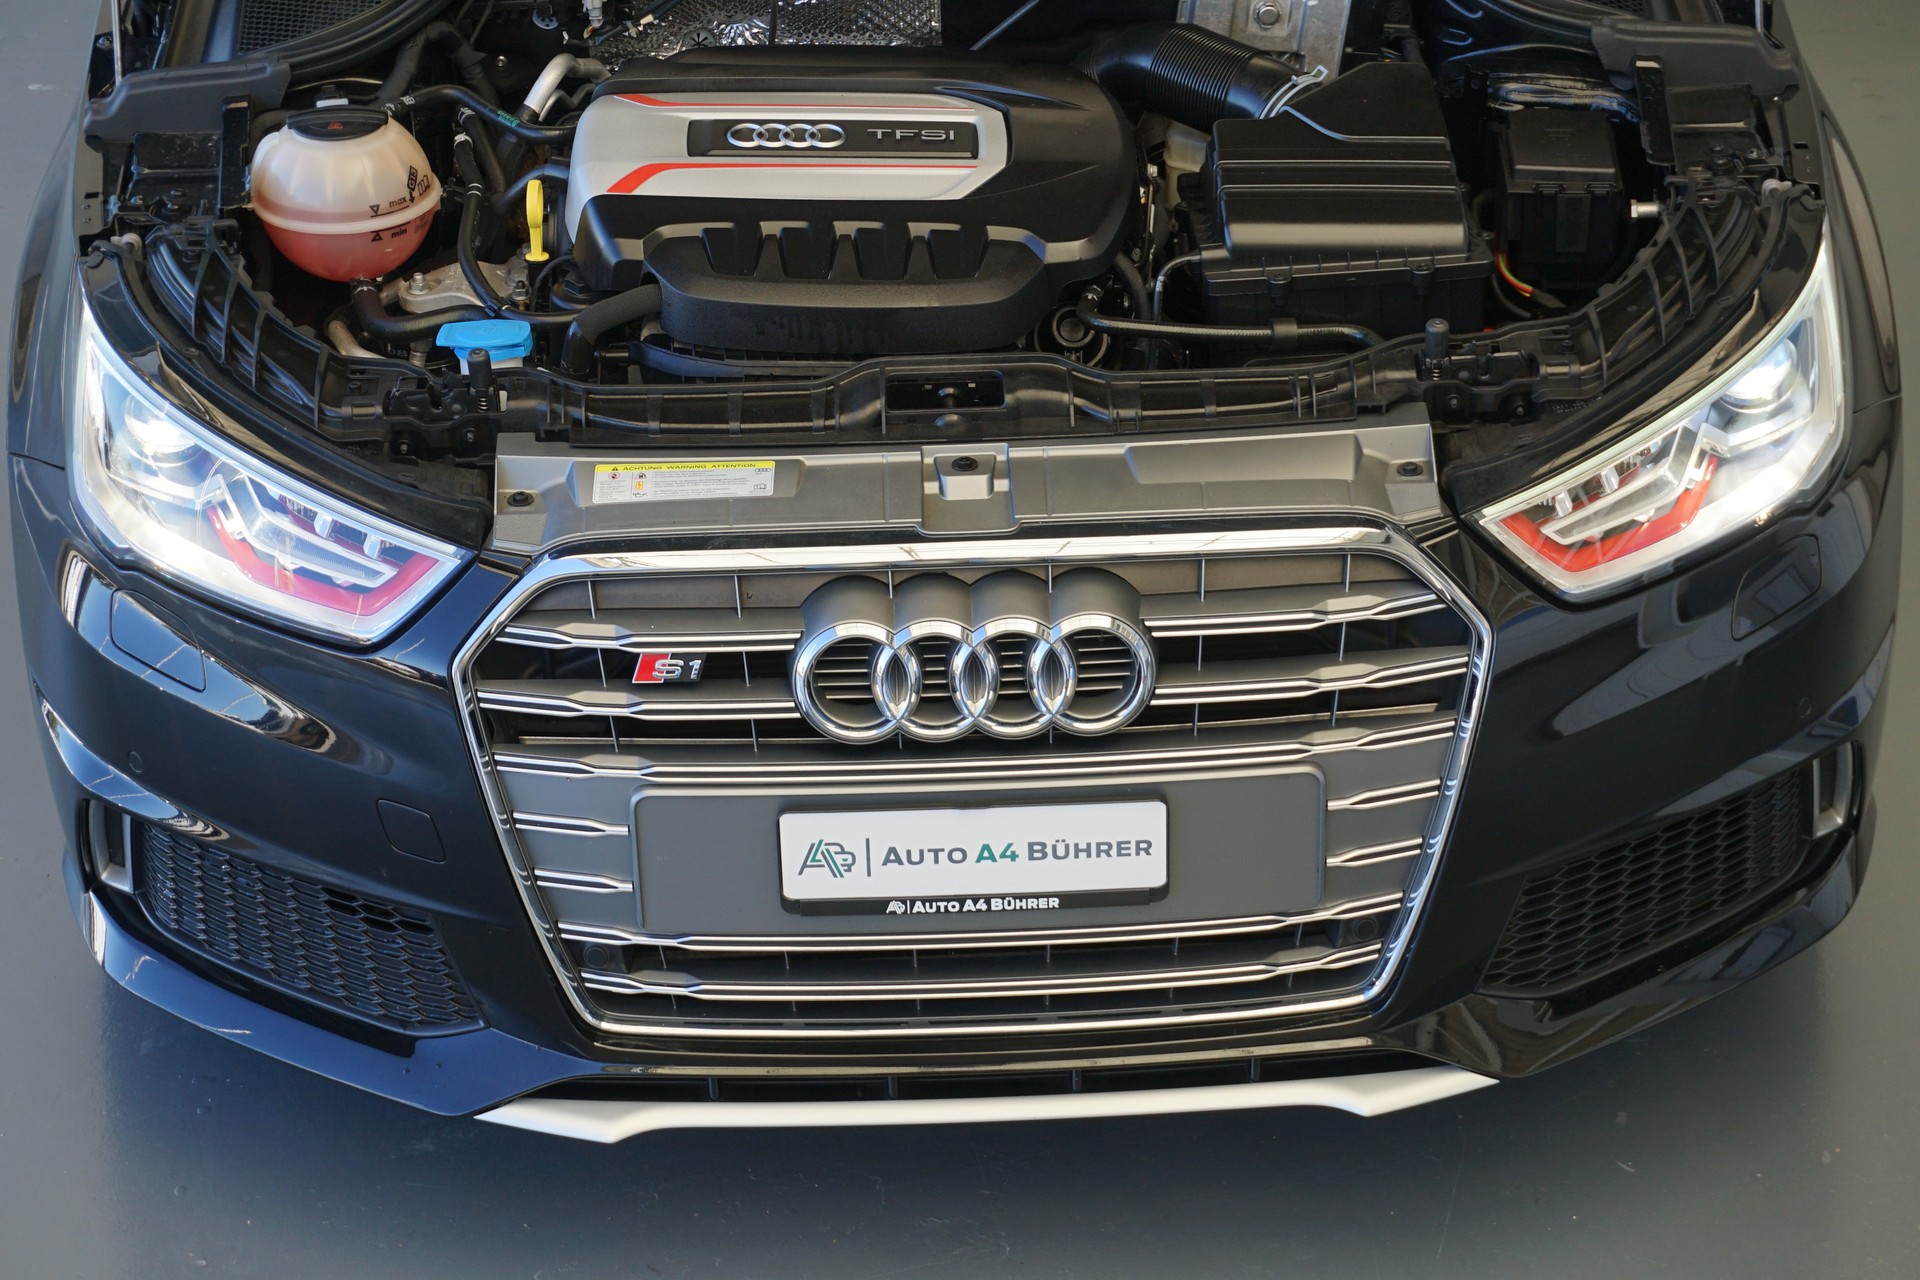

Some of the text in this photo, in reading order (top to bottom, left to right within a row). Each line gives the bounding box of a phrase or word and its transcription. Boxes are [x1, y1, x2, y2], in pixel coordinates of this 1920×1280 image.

[867, 128, 955, 140] TFSI
[408, 168, 418, 190] G13
[389, 197, 407, 207] max
[391, 228, 407, 238] min
[652, 659, 702, 679] S1
[881, 846, 968, 866] AUTO
[975, 843, 1019, 863] A4
[1027, 839, 1153, 861] BÜHRER
[912, 900, 960, 913] AUTO
[962, 898, 988, 912] A4
[991, 897, 1060, 911] BÜHRER
